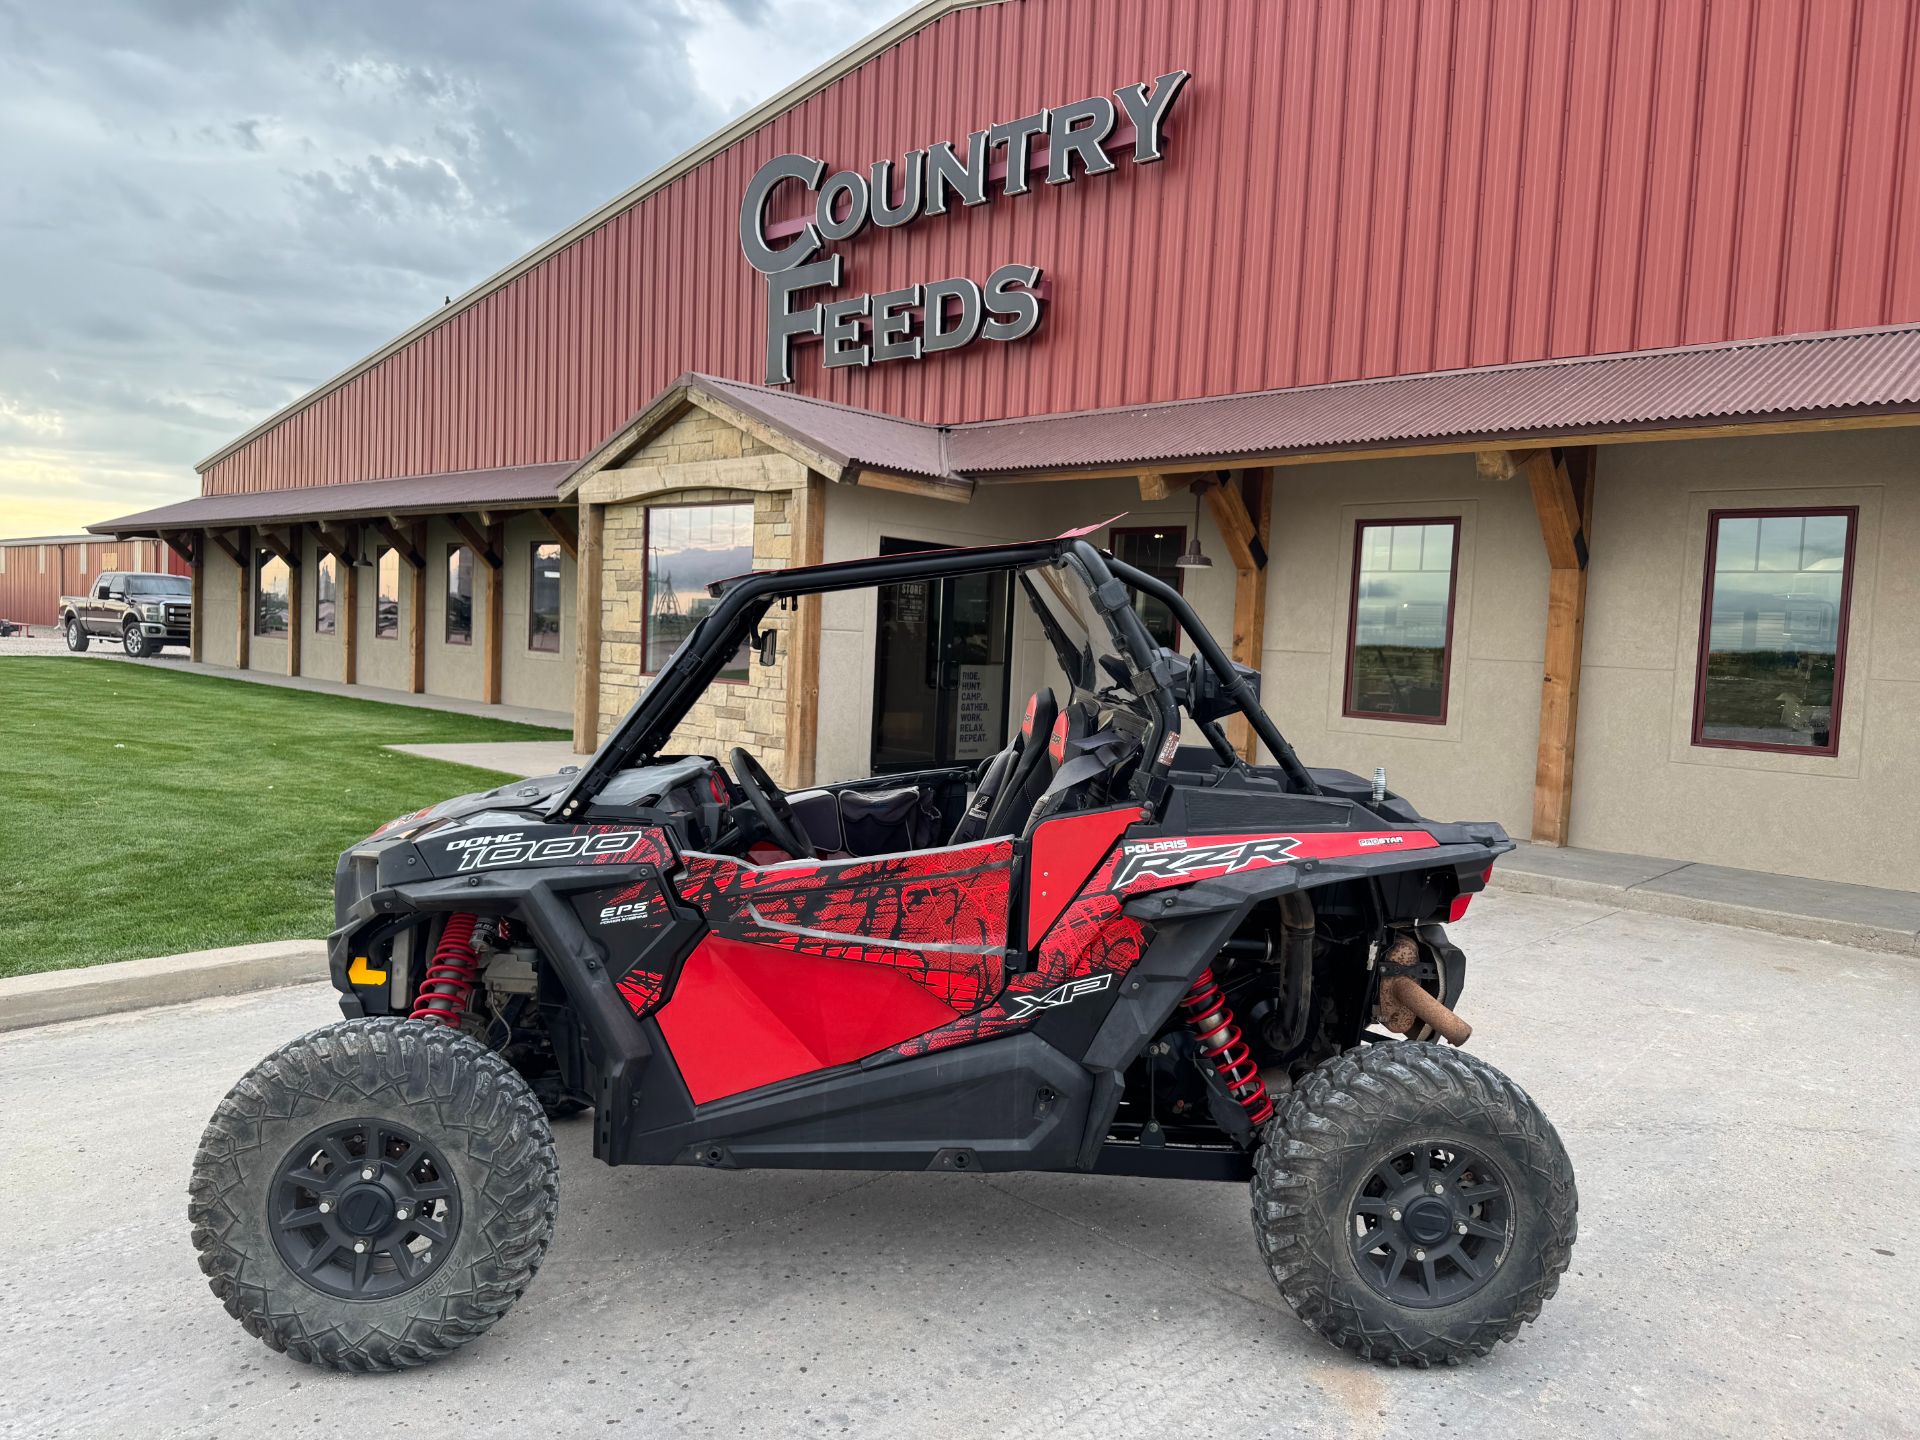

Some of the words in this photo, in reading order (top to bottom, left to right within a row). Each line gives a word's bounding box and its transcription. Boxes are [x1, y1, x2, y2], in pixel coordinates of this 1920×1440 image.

[740, 69, 1191, 273] COUNTRY
[764, 253, 1044, 385] FEEDS
[962, 672, 980, 680] RIDE.
[962, 682, 982, 691] HUNT.
[961, 692, 983, 701] CAMP.
[960, 703, 989, 711] GATHER.
[960, 713, 982, 722] WORK.
[960, 723, 985, 732] RELAX.
[959, 734, 987, 743] REPEAT.
[446, 832, 524, 851] DOHC
[1124, 839, 1188, 856] POLARIS
[457, 831, 642, 871] 1000
[1112, 836, 1303, 890] RZR
[600, 901, 649, 918] EPS
[1006, 973, 1112, 1020] XP
